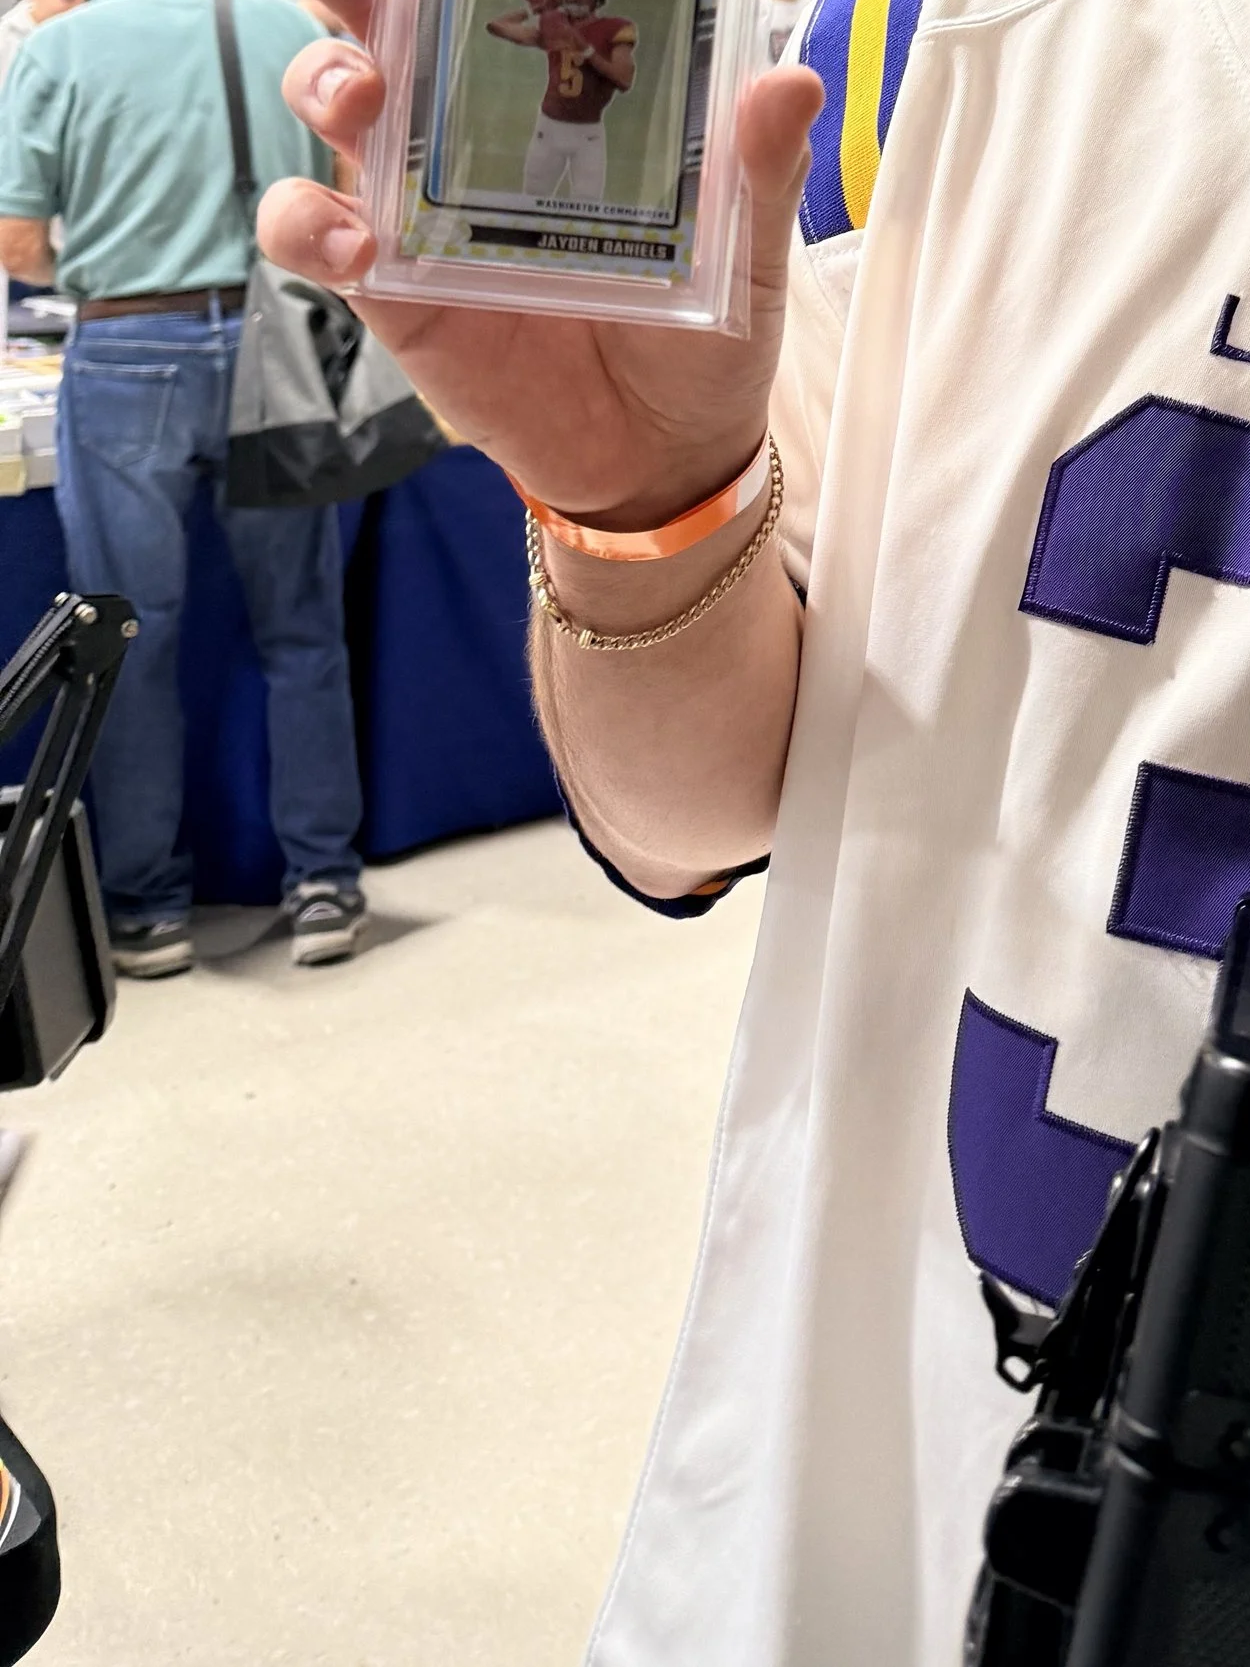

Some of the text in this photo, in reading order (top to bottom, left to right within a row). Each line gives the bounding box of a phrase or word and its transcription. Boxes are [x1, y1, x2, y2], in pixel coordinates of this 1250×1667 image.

[558, 45, 584, 99] 5
[535, 199, 600, 213] WASHINGTON
[538, 233, 668, 260] JAYDEN DANIELS
